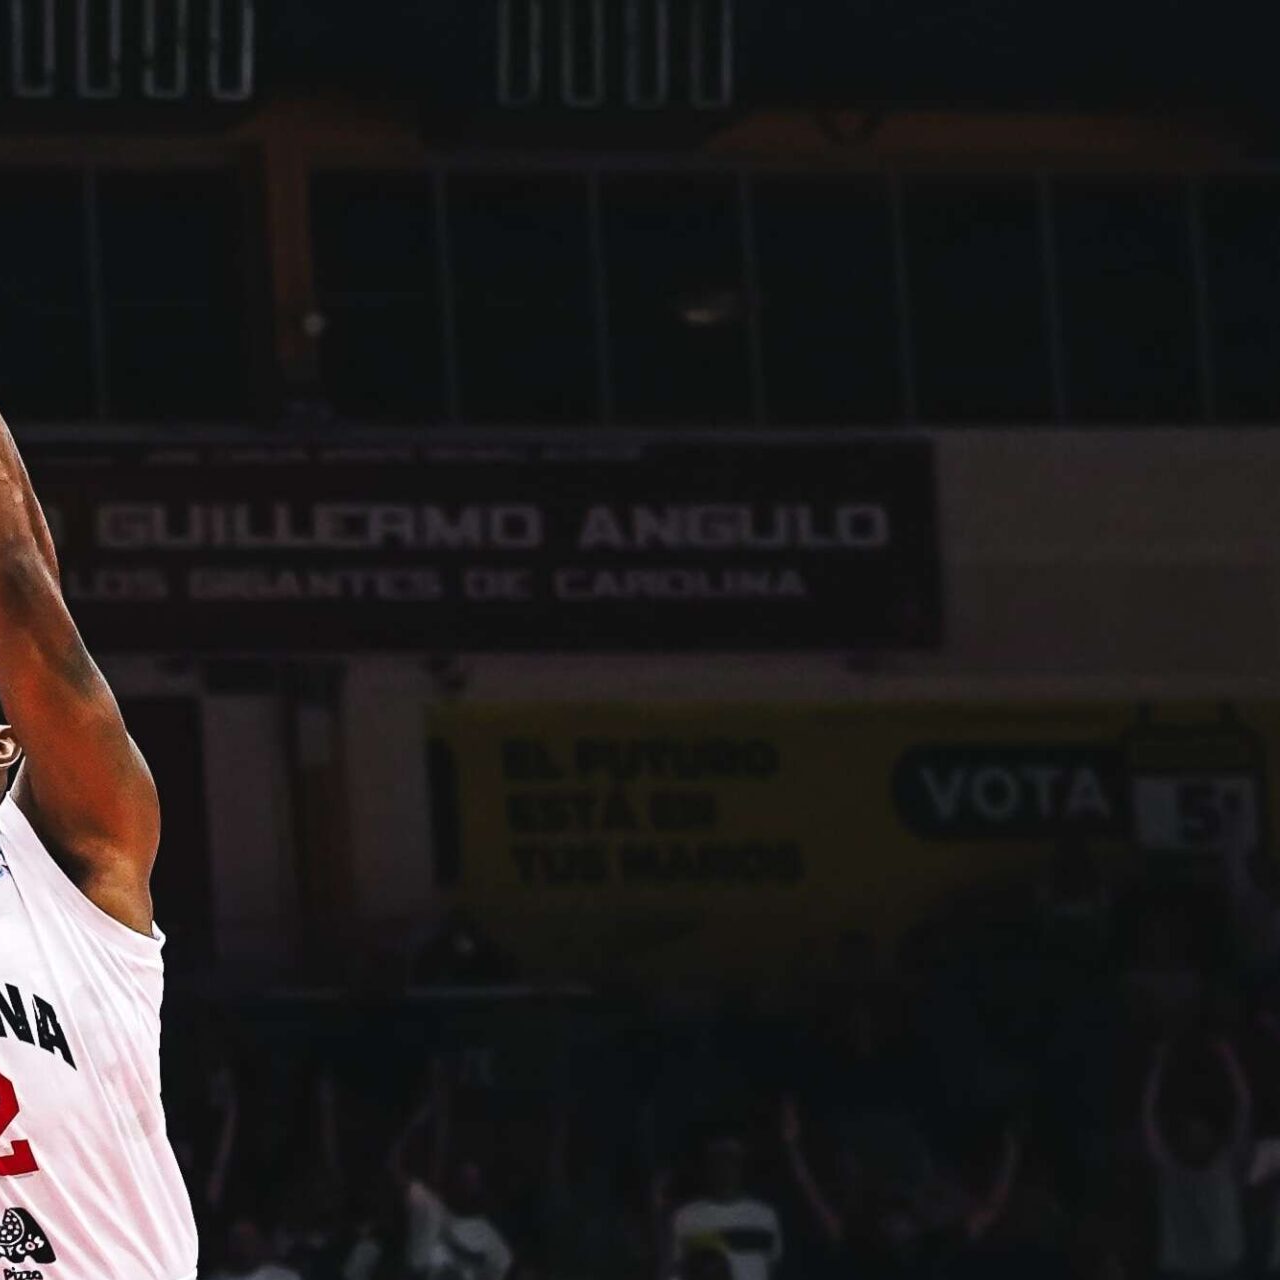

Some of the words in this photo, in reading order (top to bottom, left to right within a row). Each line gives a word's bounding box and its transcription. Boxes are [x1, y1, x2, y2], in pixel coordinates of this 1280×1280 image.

[98, 503, 543, 549] GUILLERMO
[579, 503, 890, 549] ANGULO
[188, 568, 443, 599] GIGANTES
[464, 568, 530, 599] DE
[554, 568, 808, 599] CAROLINA
[921, 763, 1113, 822] VOTA
